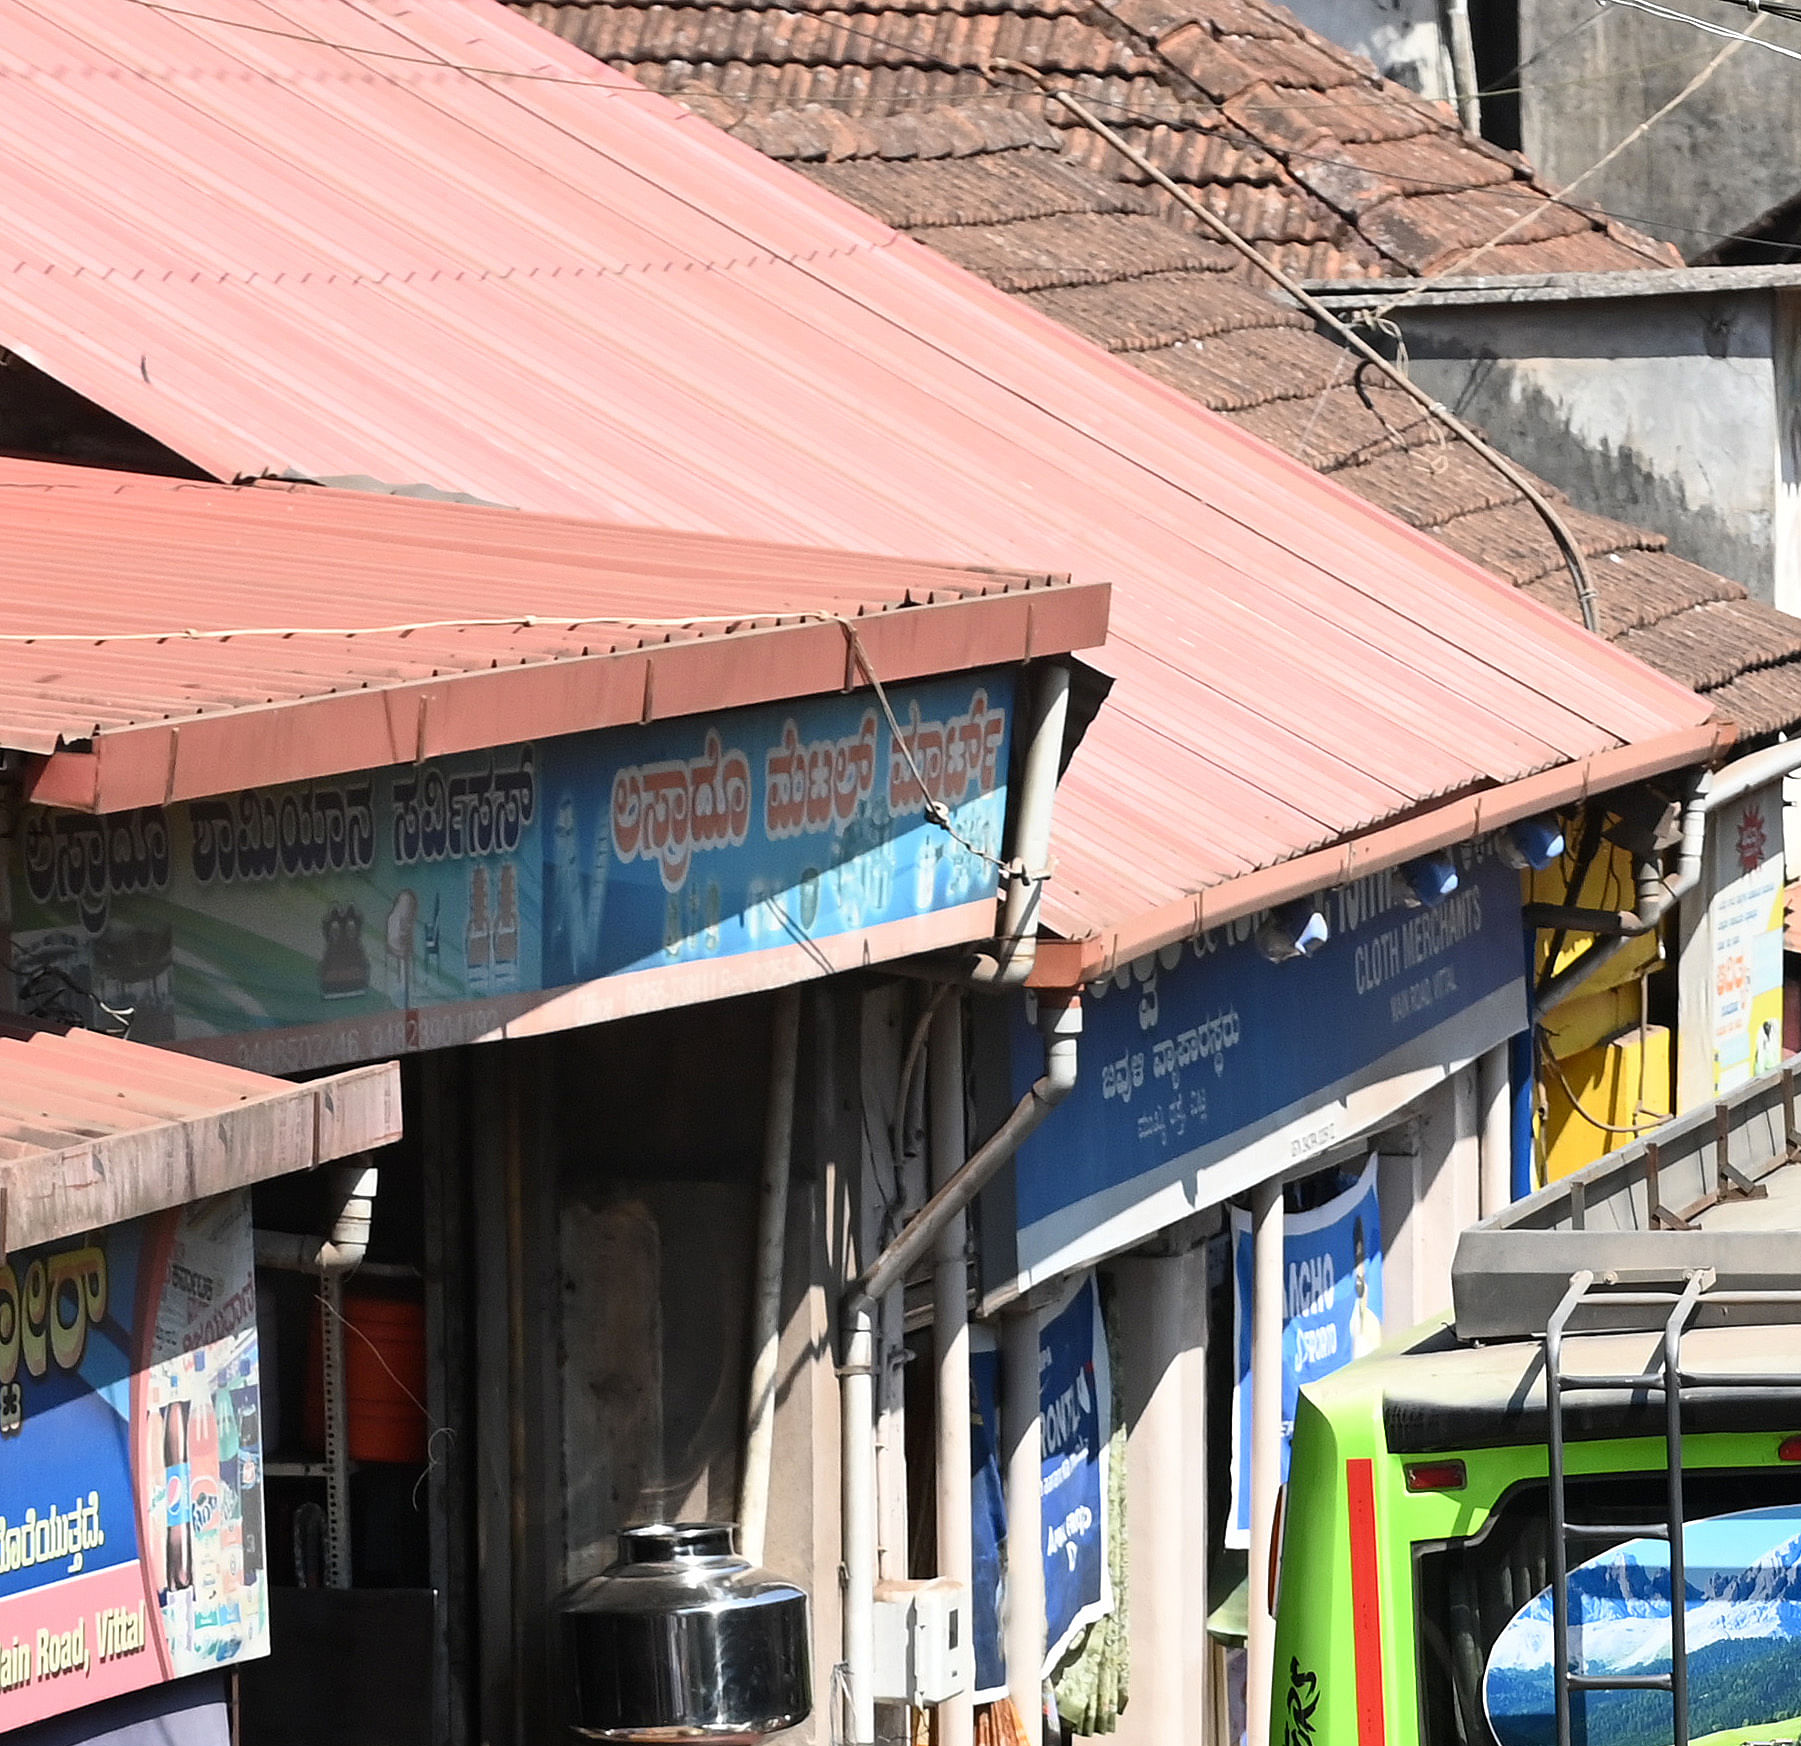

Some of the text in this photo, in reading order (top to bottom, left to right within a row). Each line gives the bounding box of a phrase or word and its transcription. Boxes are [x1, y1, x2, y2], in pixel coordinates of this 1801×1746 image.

[1354, 927, 1401, 996] CLOTH
[1402, 884, 1482, 969] MERCHANTS
[1283, 1252, 1335, 1319] ACHO
[0, 1598, 146, 1694] ain Road, Vittal
